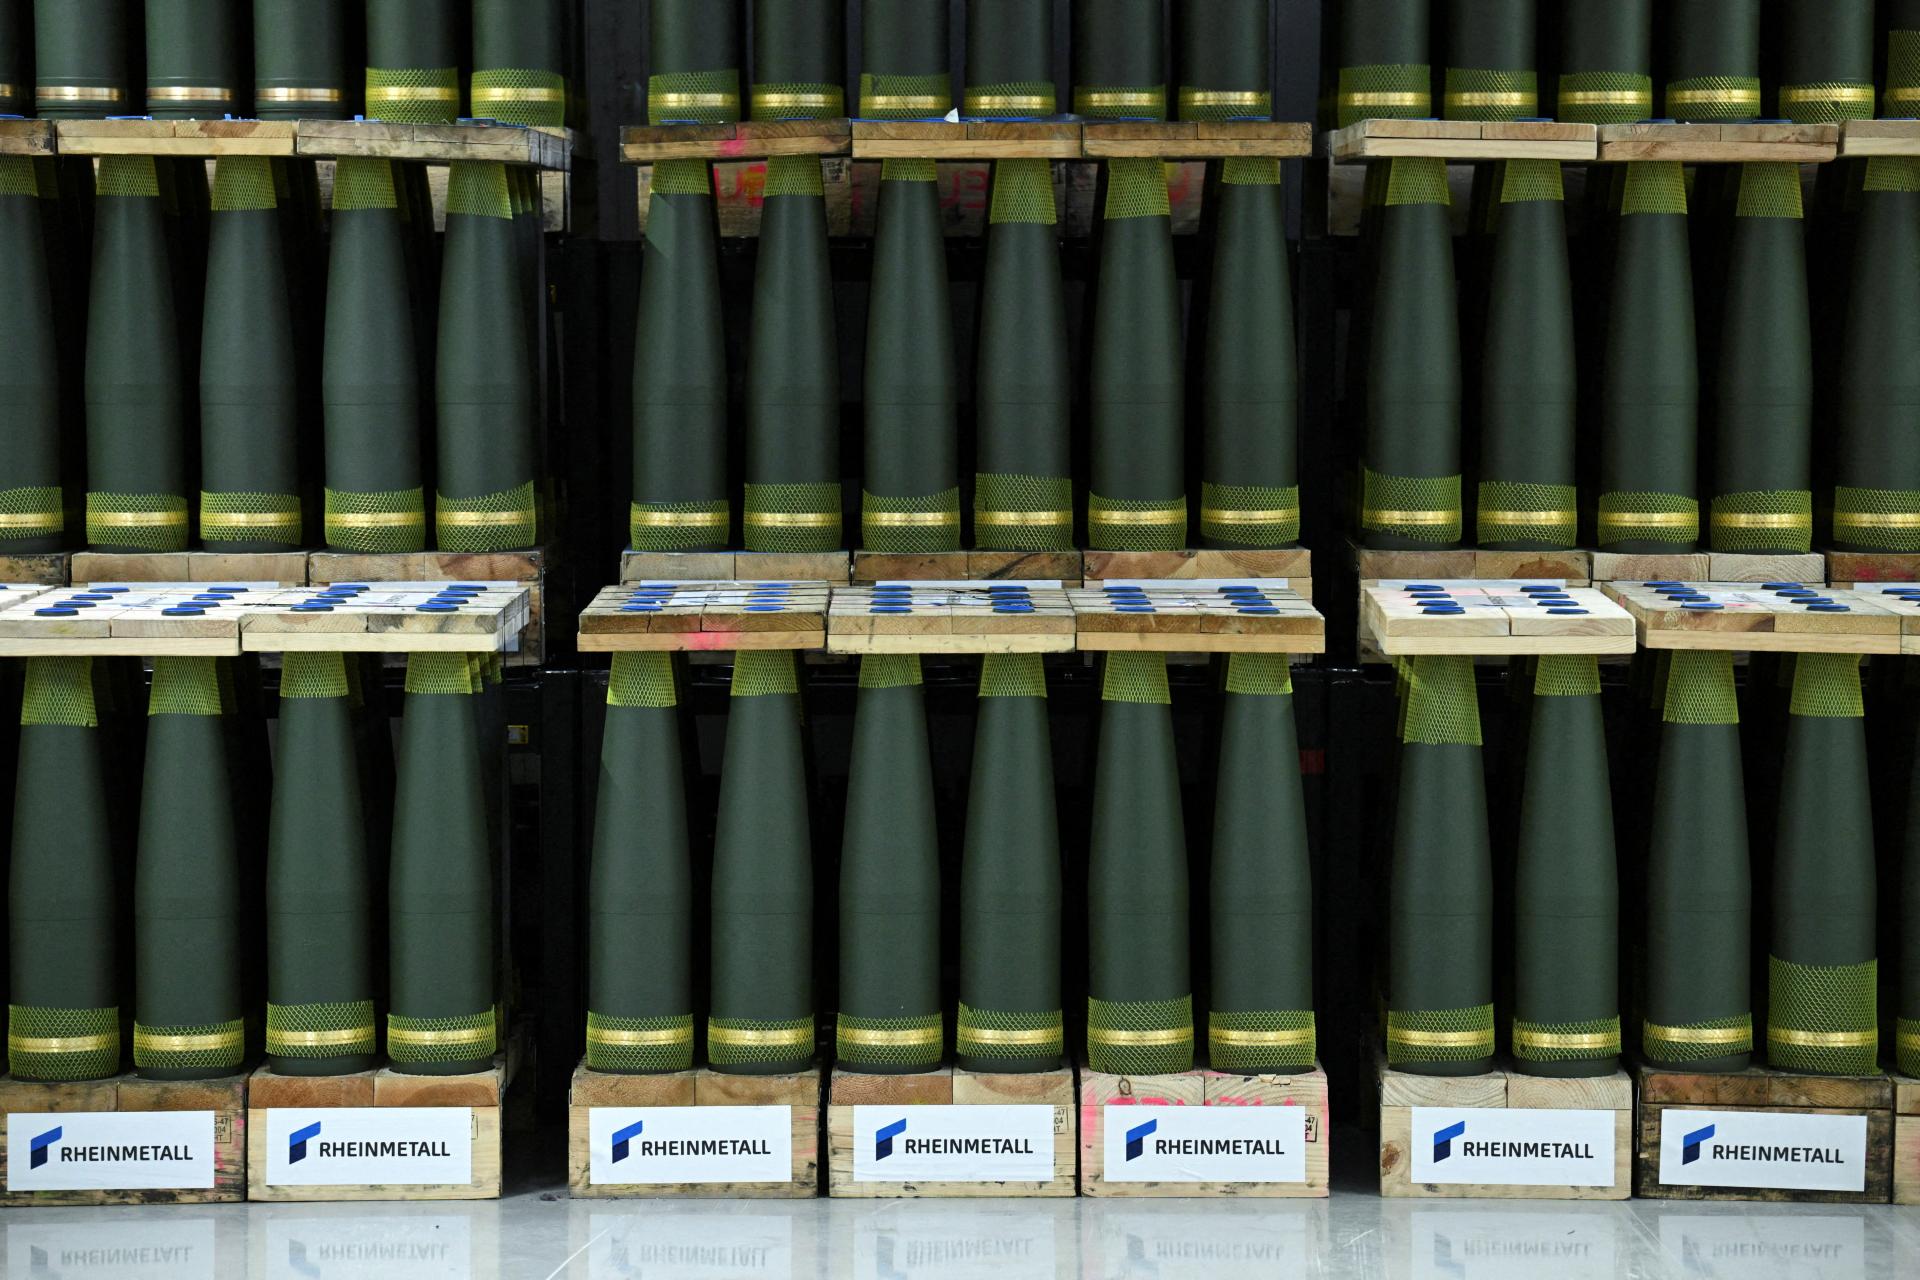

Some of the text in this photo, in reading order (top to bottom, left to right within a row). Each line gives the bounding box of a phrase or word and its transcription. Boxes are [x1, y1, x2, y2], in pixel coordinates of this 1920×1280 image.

[61, 1145, 193, 1162] RHEINMETALL
[320, 1142, 451, 1158] RHEINMETALL
[642, 1140, 772, 1156] RHEINMETALL
[906, 1139, 1034, 1154] RHEINMETALL
[1156, 1140, 1285, 1155] RHEINMETALL
[1464, 1142, 1594, 1158] RHEINMETALL
[1713, 1145, 1845, 1163] RHEINMETALL
